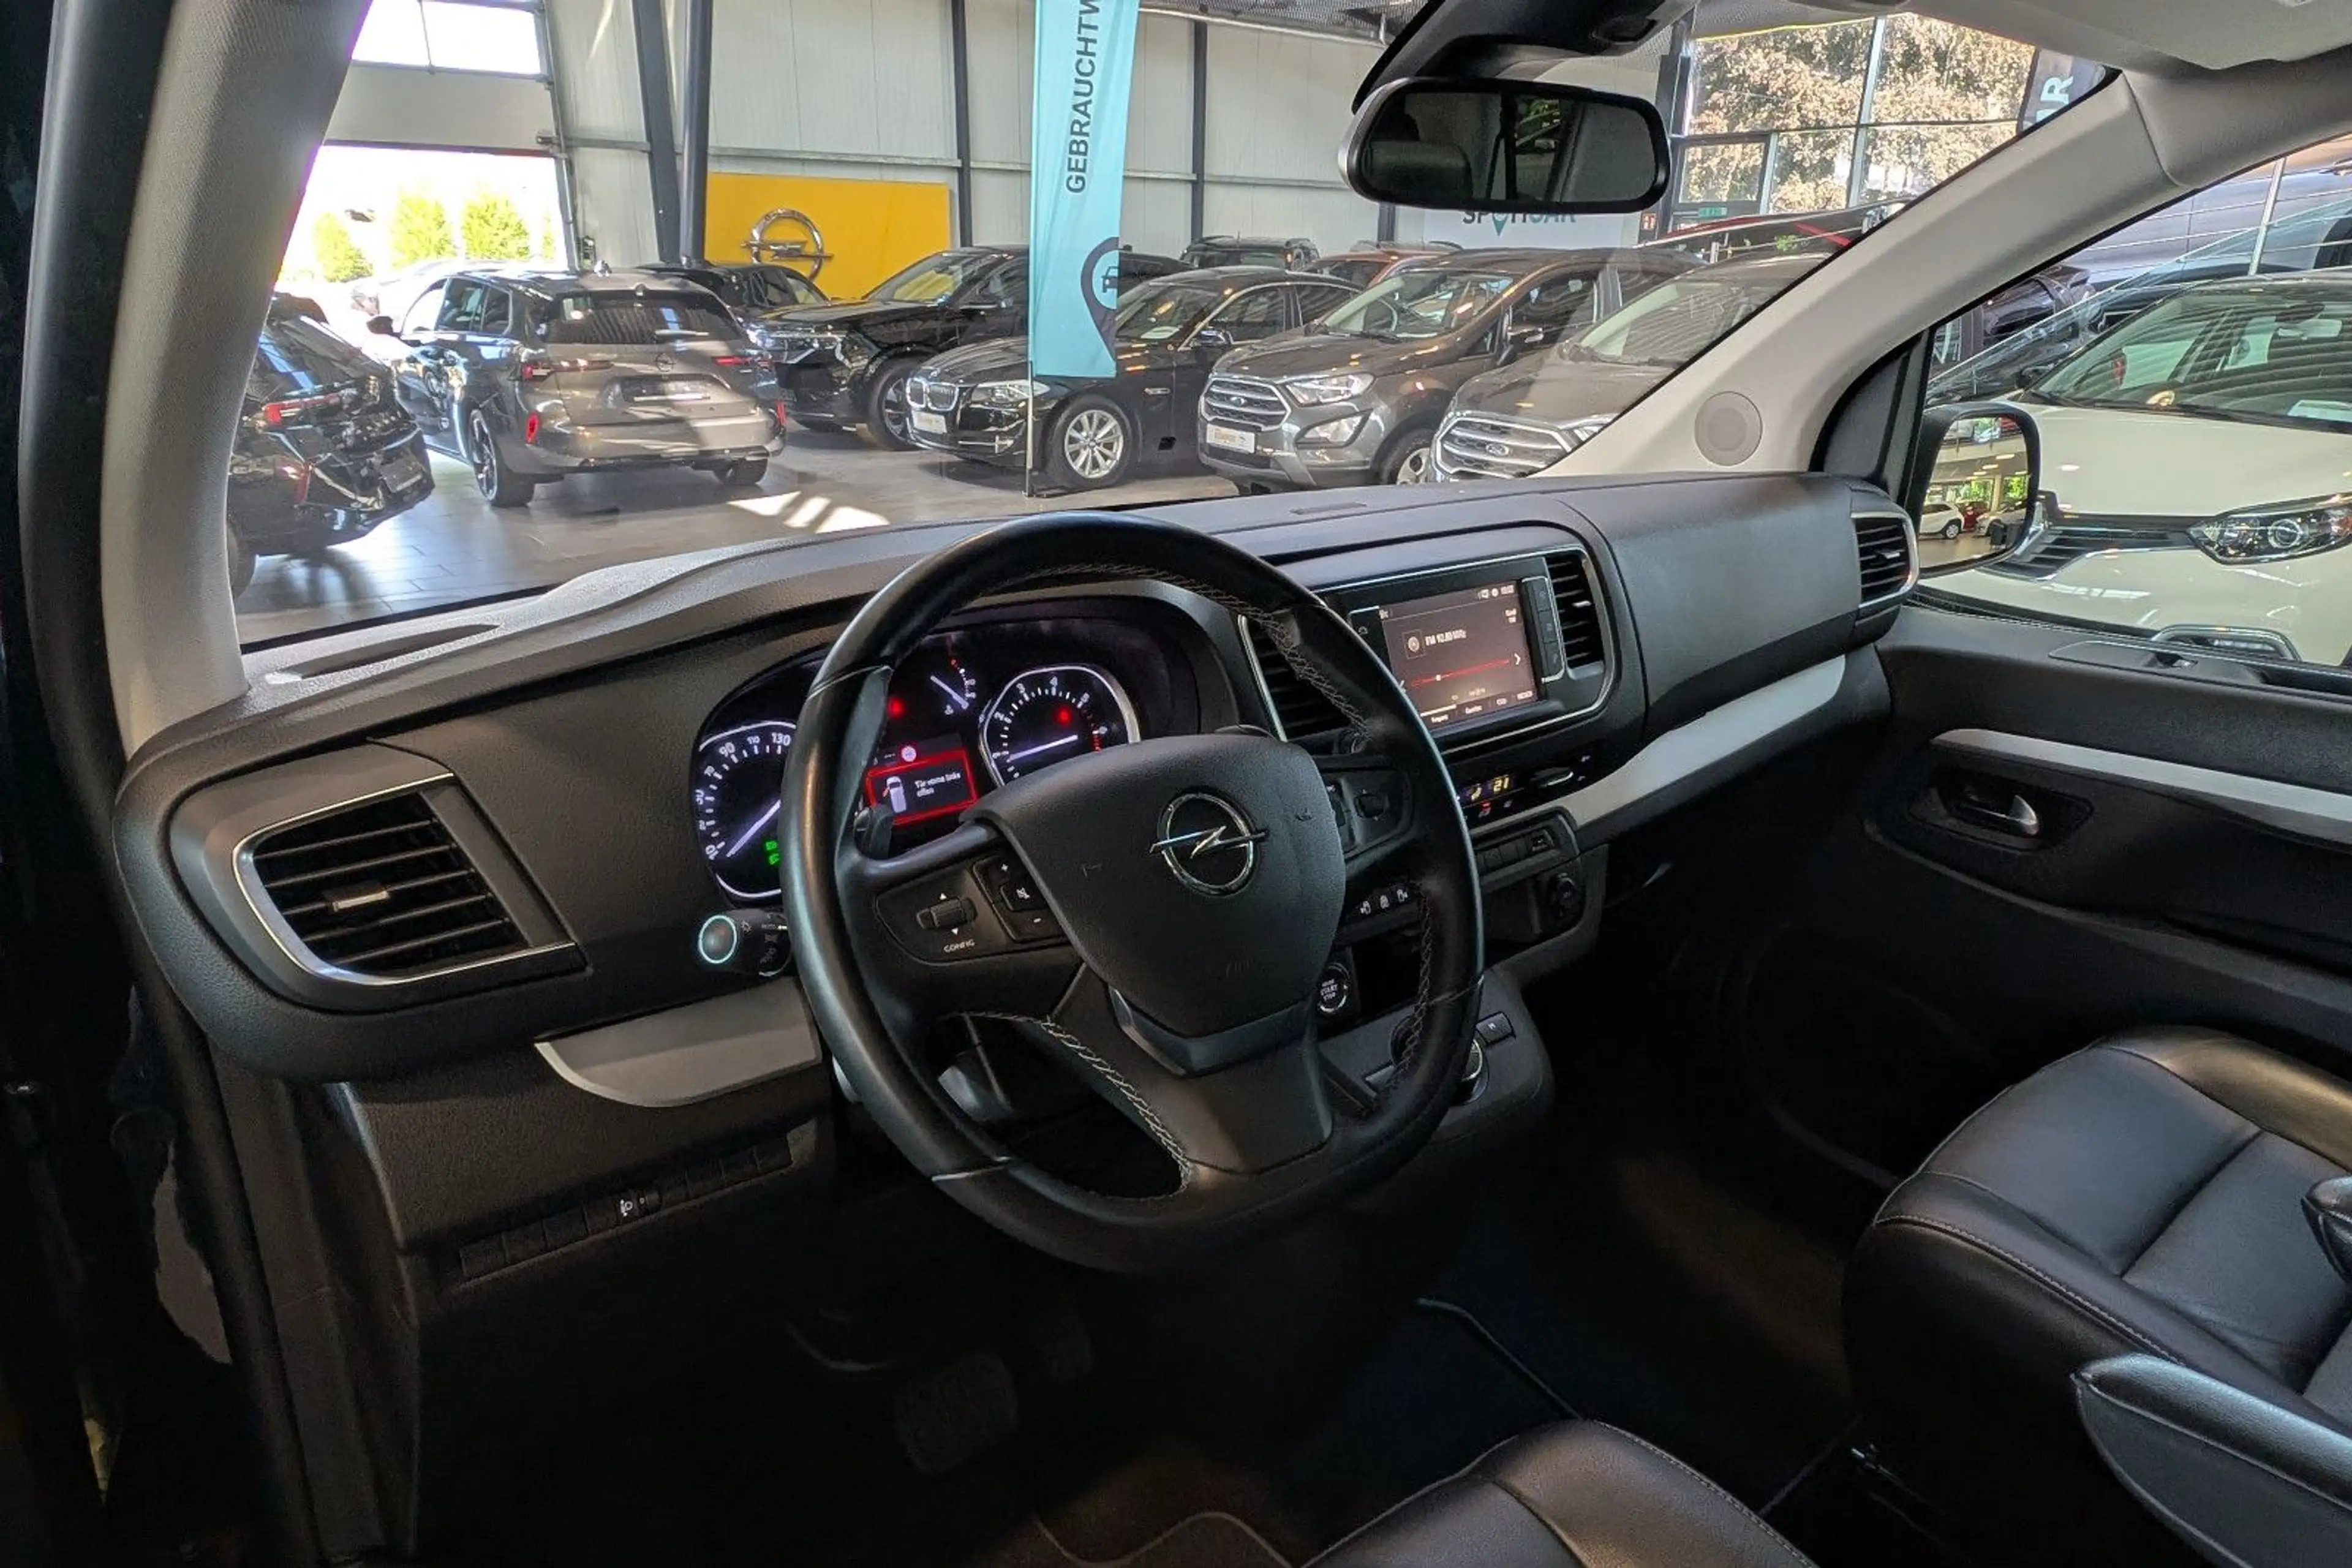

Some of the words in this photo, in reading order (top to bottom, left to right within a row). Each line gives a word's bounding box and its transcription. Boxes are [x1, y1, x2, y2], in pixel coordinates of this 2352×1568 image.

[746, 736, 761, 745] 110
[771, 732, 792, 747] 130
[718, 742, 736, 758] 90
[1493, 775, 1510, 793] 21
[705, 845, 719, 861] 10
